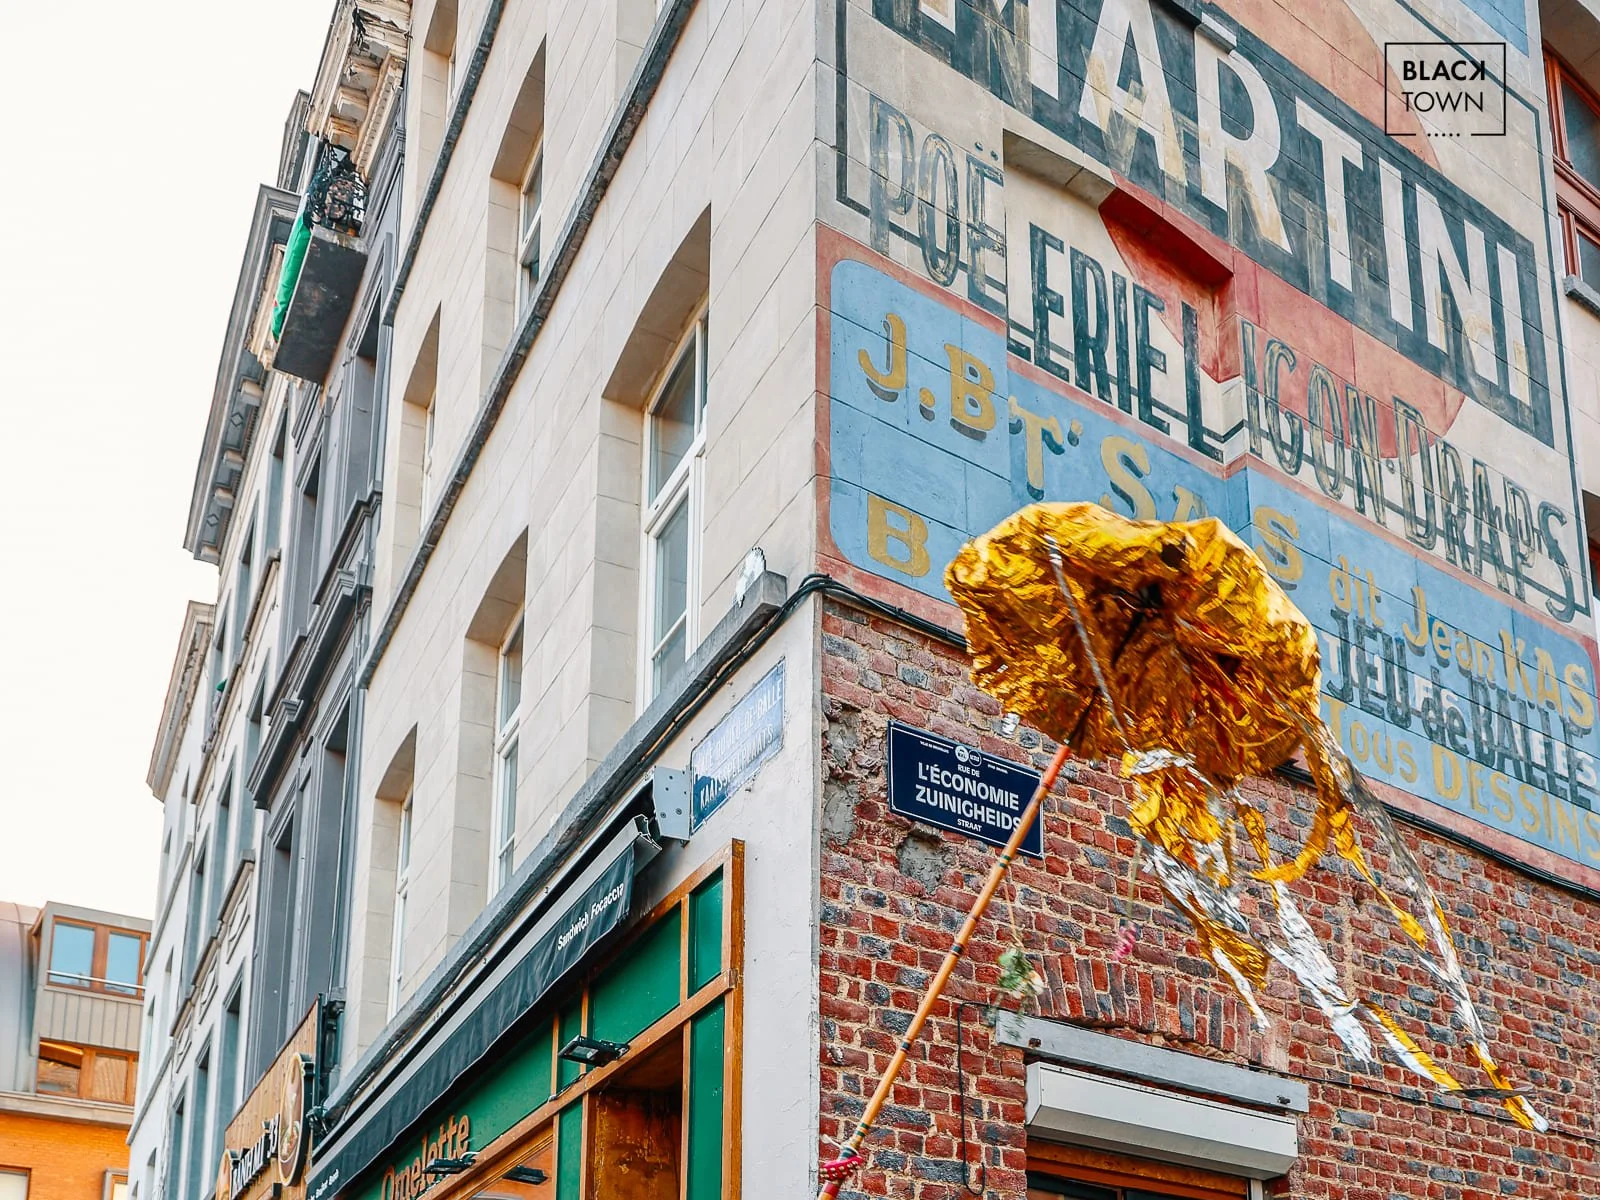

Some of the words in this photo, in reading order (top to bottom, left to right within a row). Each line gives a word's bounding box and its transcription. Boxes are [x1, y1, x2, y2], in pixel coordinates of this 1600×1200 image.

[1329, 554, 1386, 628] dit
[1402, 584, 1496, 686] Jean
[1499, 629, 1595, 734] KAS
[1326, 608, 1412, 730] JEU
[1420, 665, 1469, 757] de
[917, 761, 1020, 811] L'ÉCONOMIE
[957, 763, 971, 775] RUE
[971, 768, 981, 778] DE
[915, 783, 1021, 833] ZUINIGHEIDS
[957, 818, 982, 833] STRAAT
[557, 911, 589, 951] Sandwich
